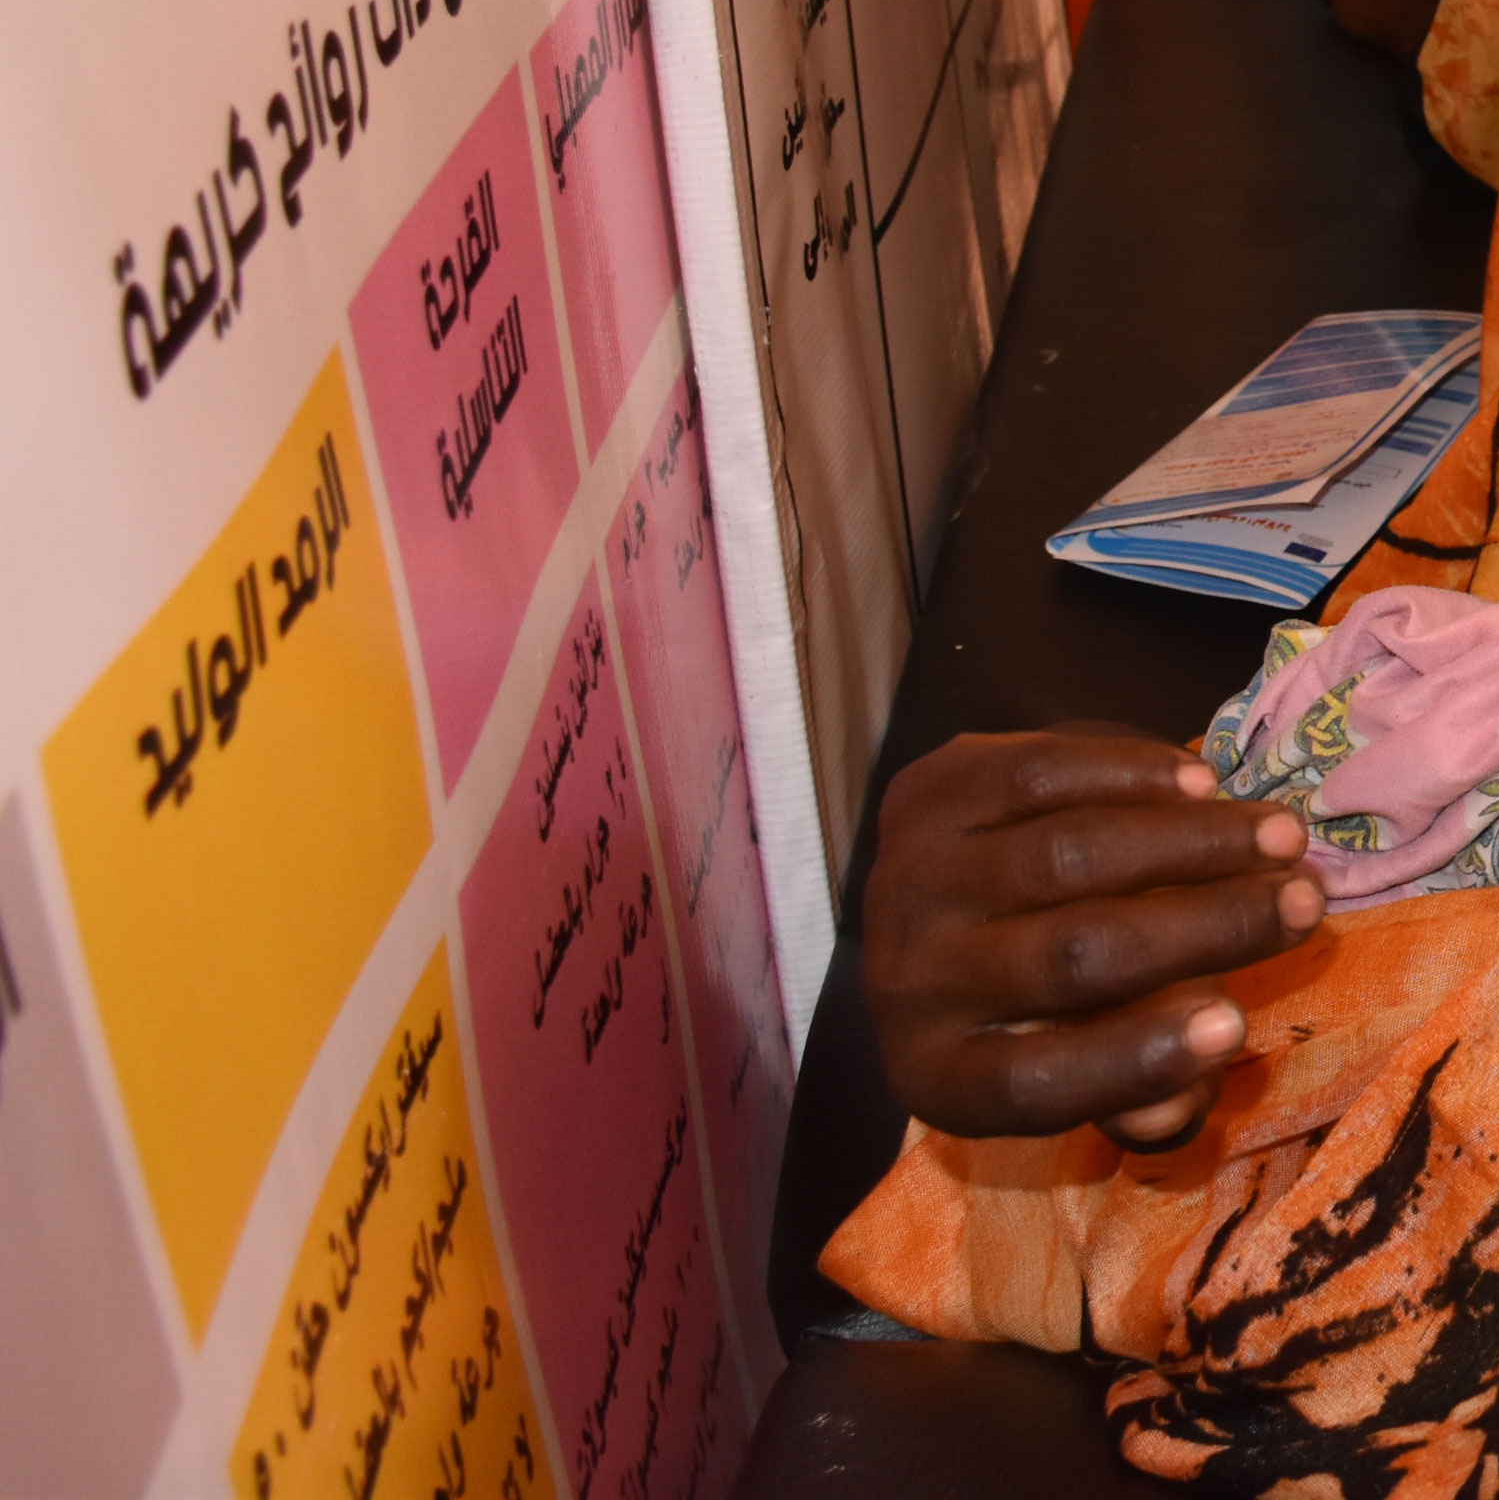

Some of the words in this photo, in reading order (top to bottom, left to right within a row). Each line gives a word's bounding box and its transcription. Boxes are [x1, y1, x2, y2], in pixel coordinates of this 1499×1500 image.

[266, 3, 369, 228] روائح
[420, 169, 501, 351] القرحة
[436, 295, 529, 520] التناسلية
[272, 431, 350, 640] الرمد
[137, 559, 268, 820] الوليد
